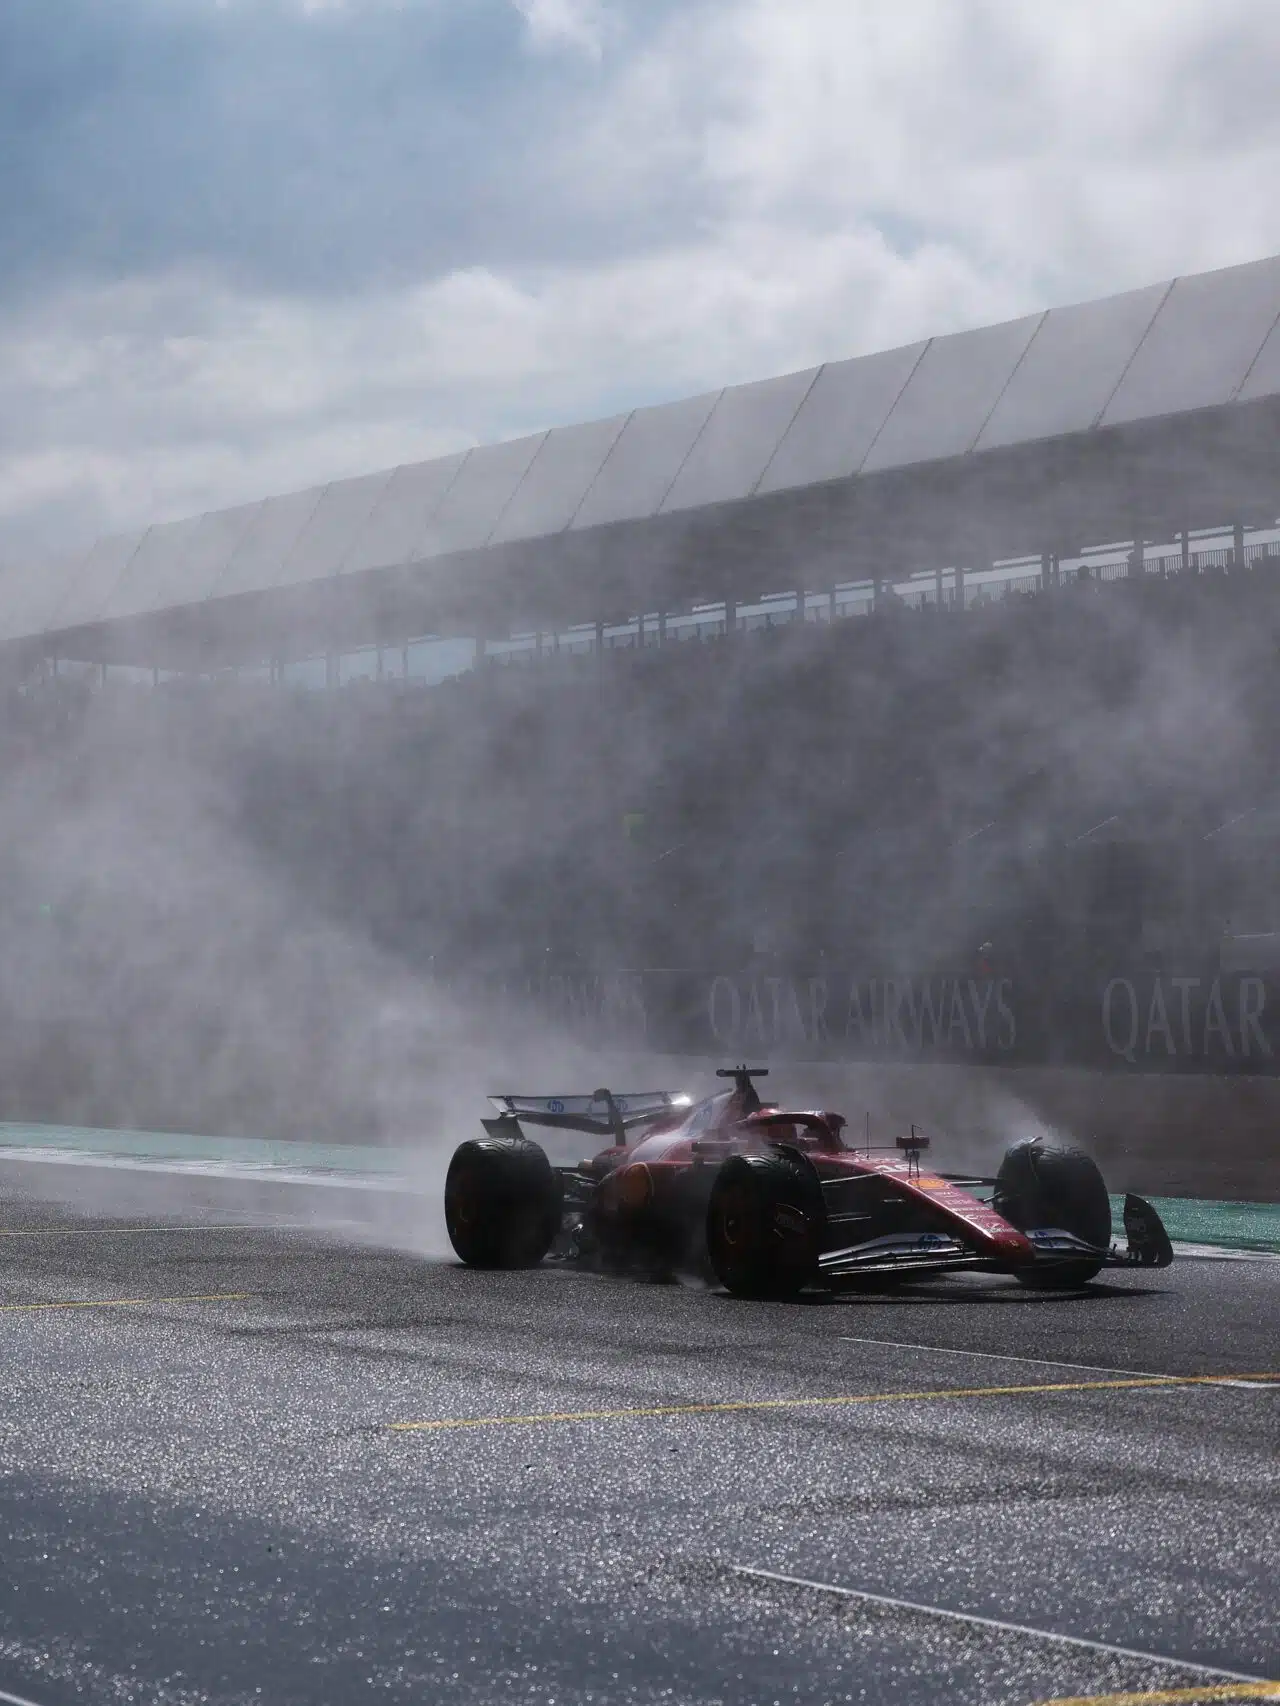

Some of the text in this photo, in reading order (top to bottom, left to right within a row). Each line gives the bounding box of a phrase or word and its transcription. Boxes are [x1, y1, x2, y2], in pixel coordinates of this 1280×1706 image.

[708, 975, 1017, 1050] QATAR AIRWAYS
[1101, 976, 1275, 1063] QATAR
